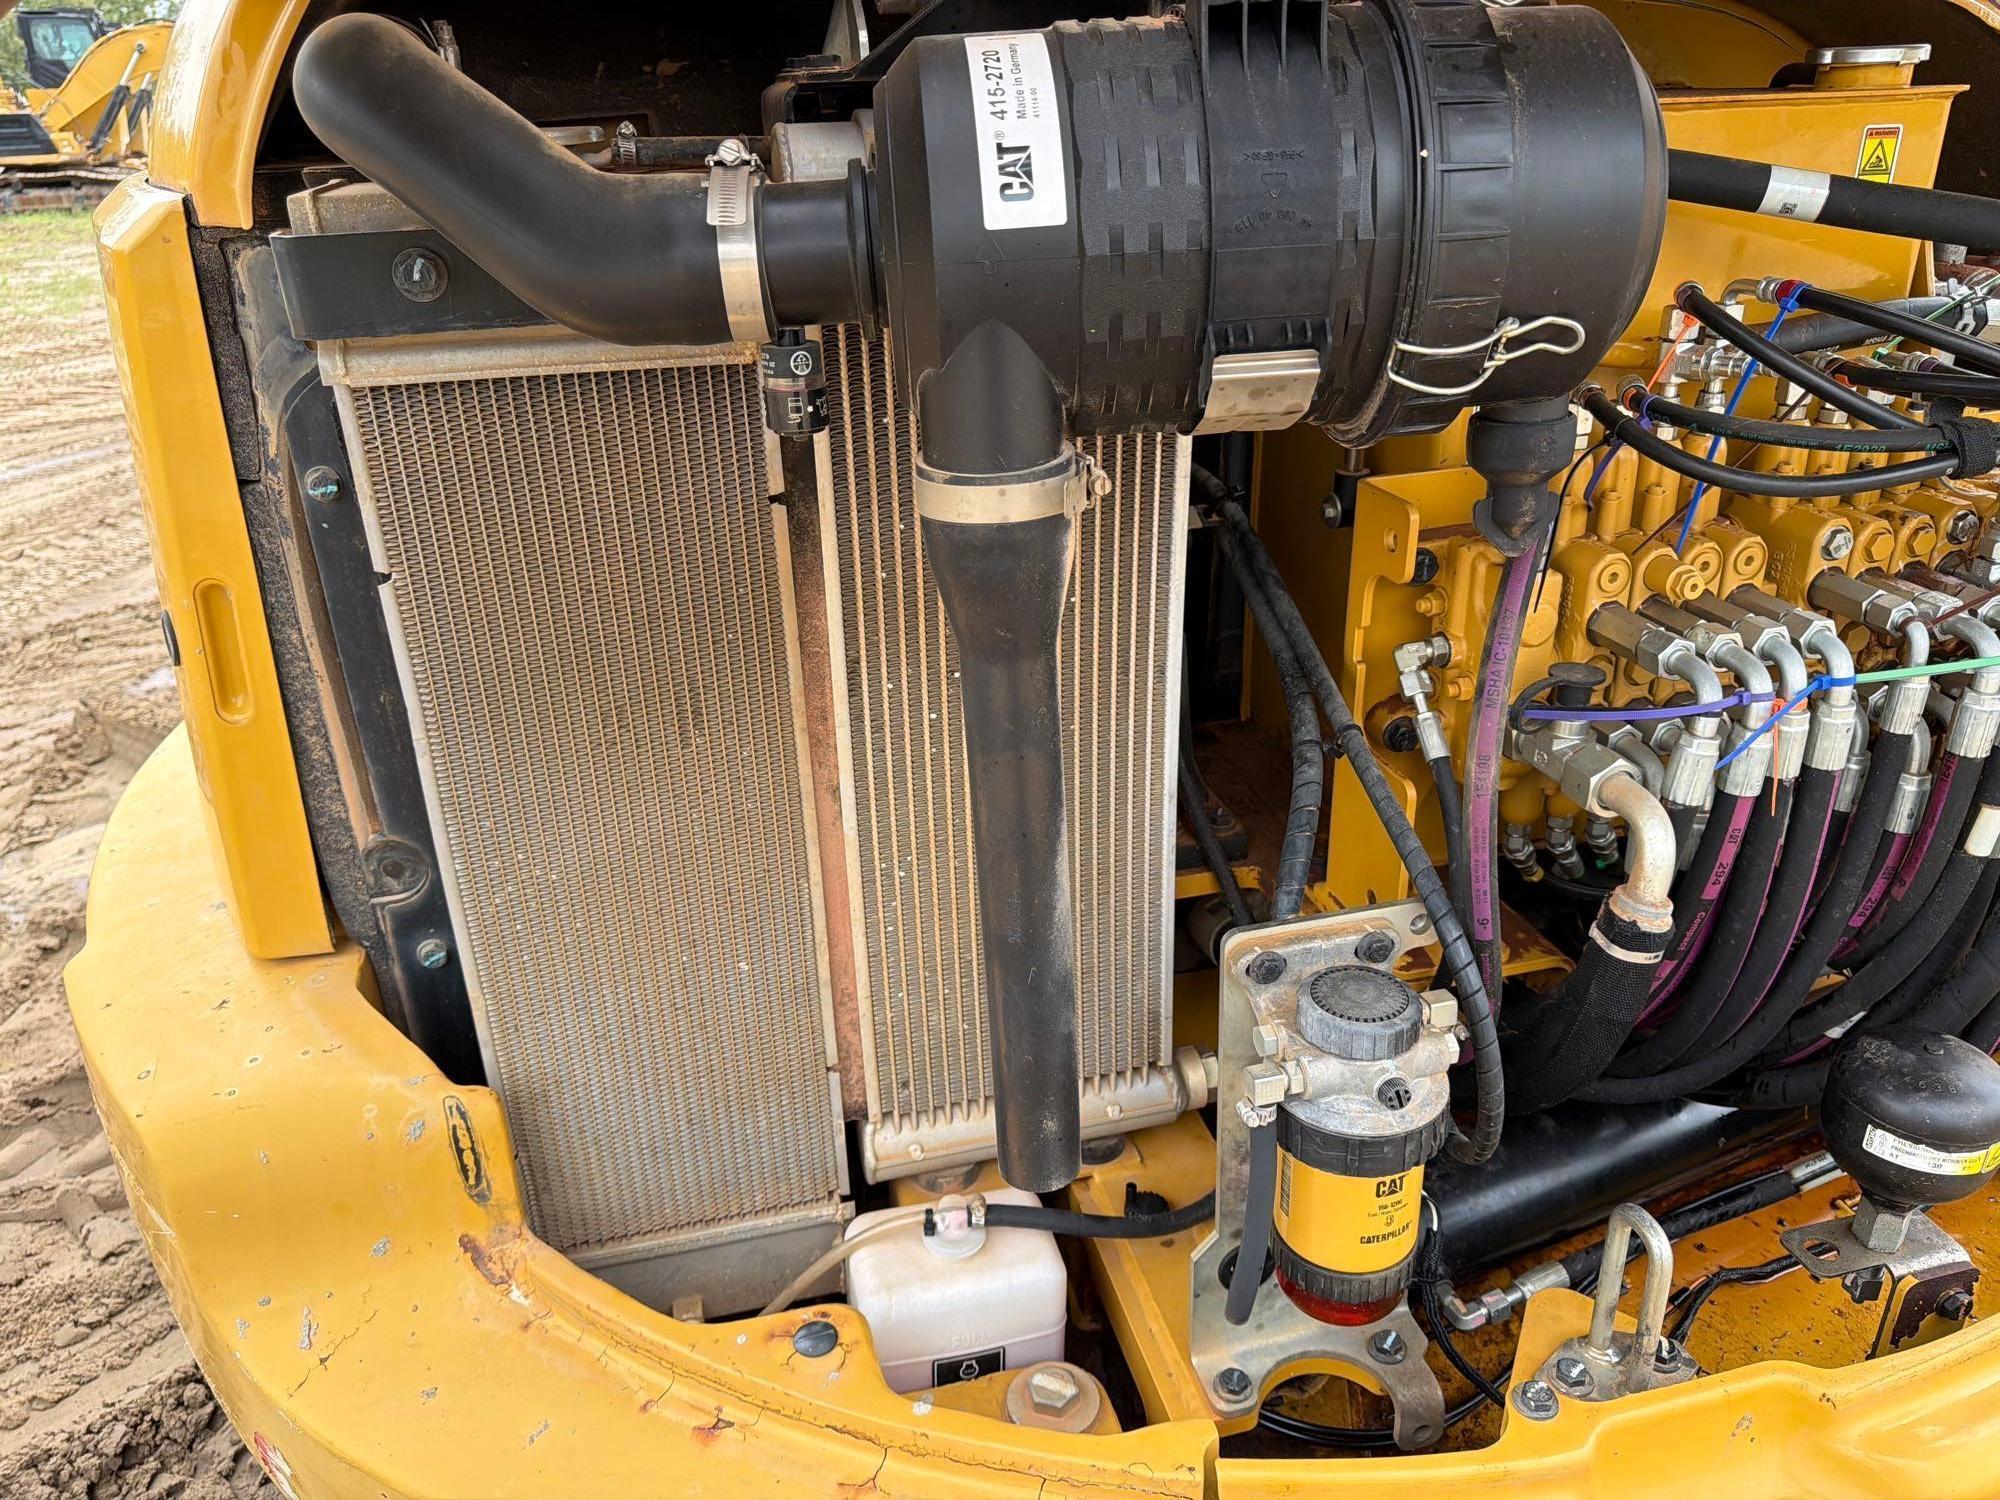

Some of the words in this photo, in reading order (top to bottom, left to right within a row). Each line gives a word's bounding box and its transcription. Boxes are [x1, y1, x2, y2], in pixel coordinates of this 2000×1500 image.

[1009, 43, 1022, 75] Germany
[981, 50, 1008, 120] 415-2720
[1012, 76, 1023, 88] in
[1016, 88, 1026, 119] Made
[1485, 669, 1501, 709] MSHA
[1712, 862, 1729, 886] 294
[1476, 917, 1489, 931] -6
